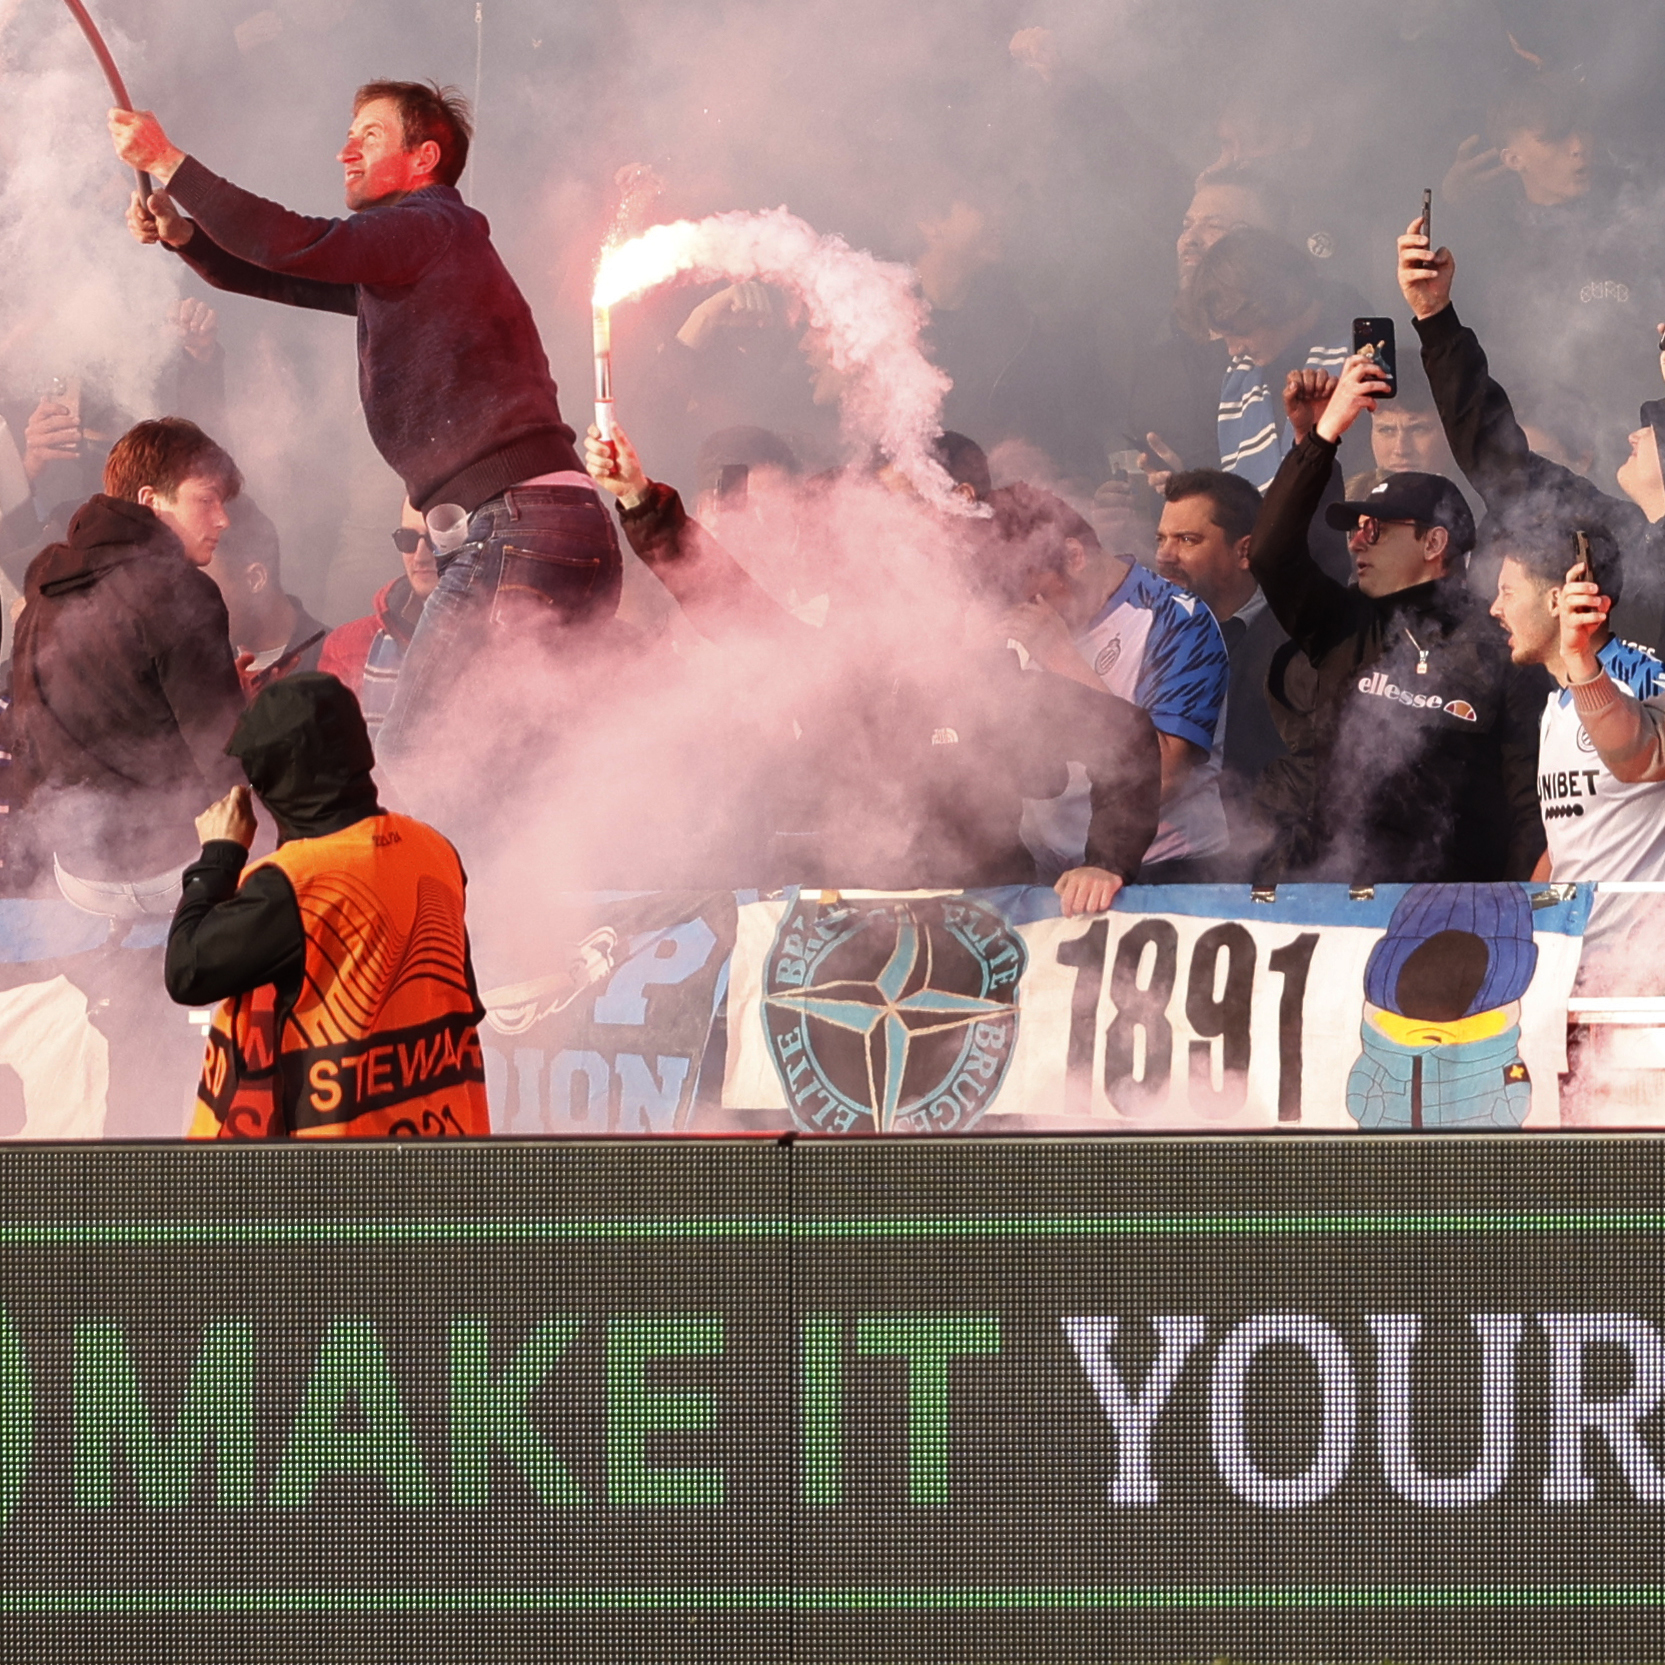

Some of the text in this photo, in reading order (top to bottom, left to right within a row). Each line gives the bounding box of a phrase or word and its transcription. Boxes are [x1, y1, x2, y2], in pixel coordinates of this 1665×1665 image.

[1357, 671, 1443, 709] ellesse
[1054, 916, 1322, 1124] 1891
[71, 1314, 726, 1514] MAKE
[798, 1314, 1003, 1513] IT
